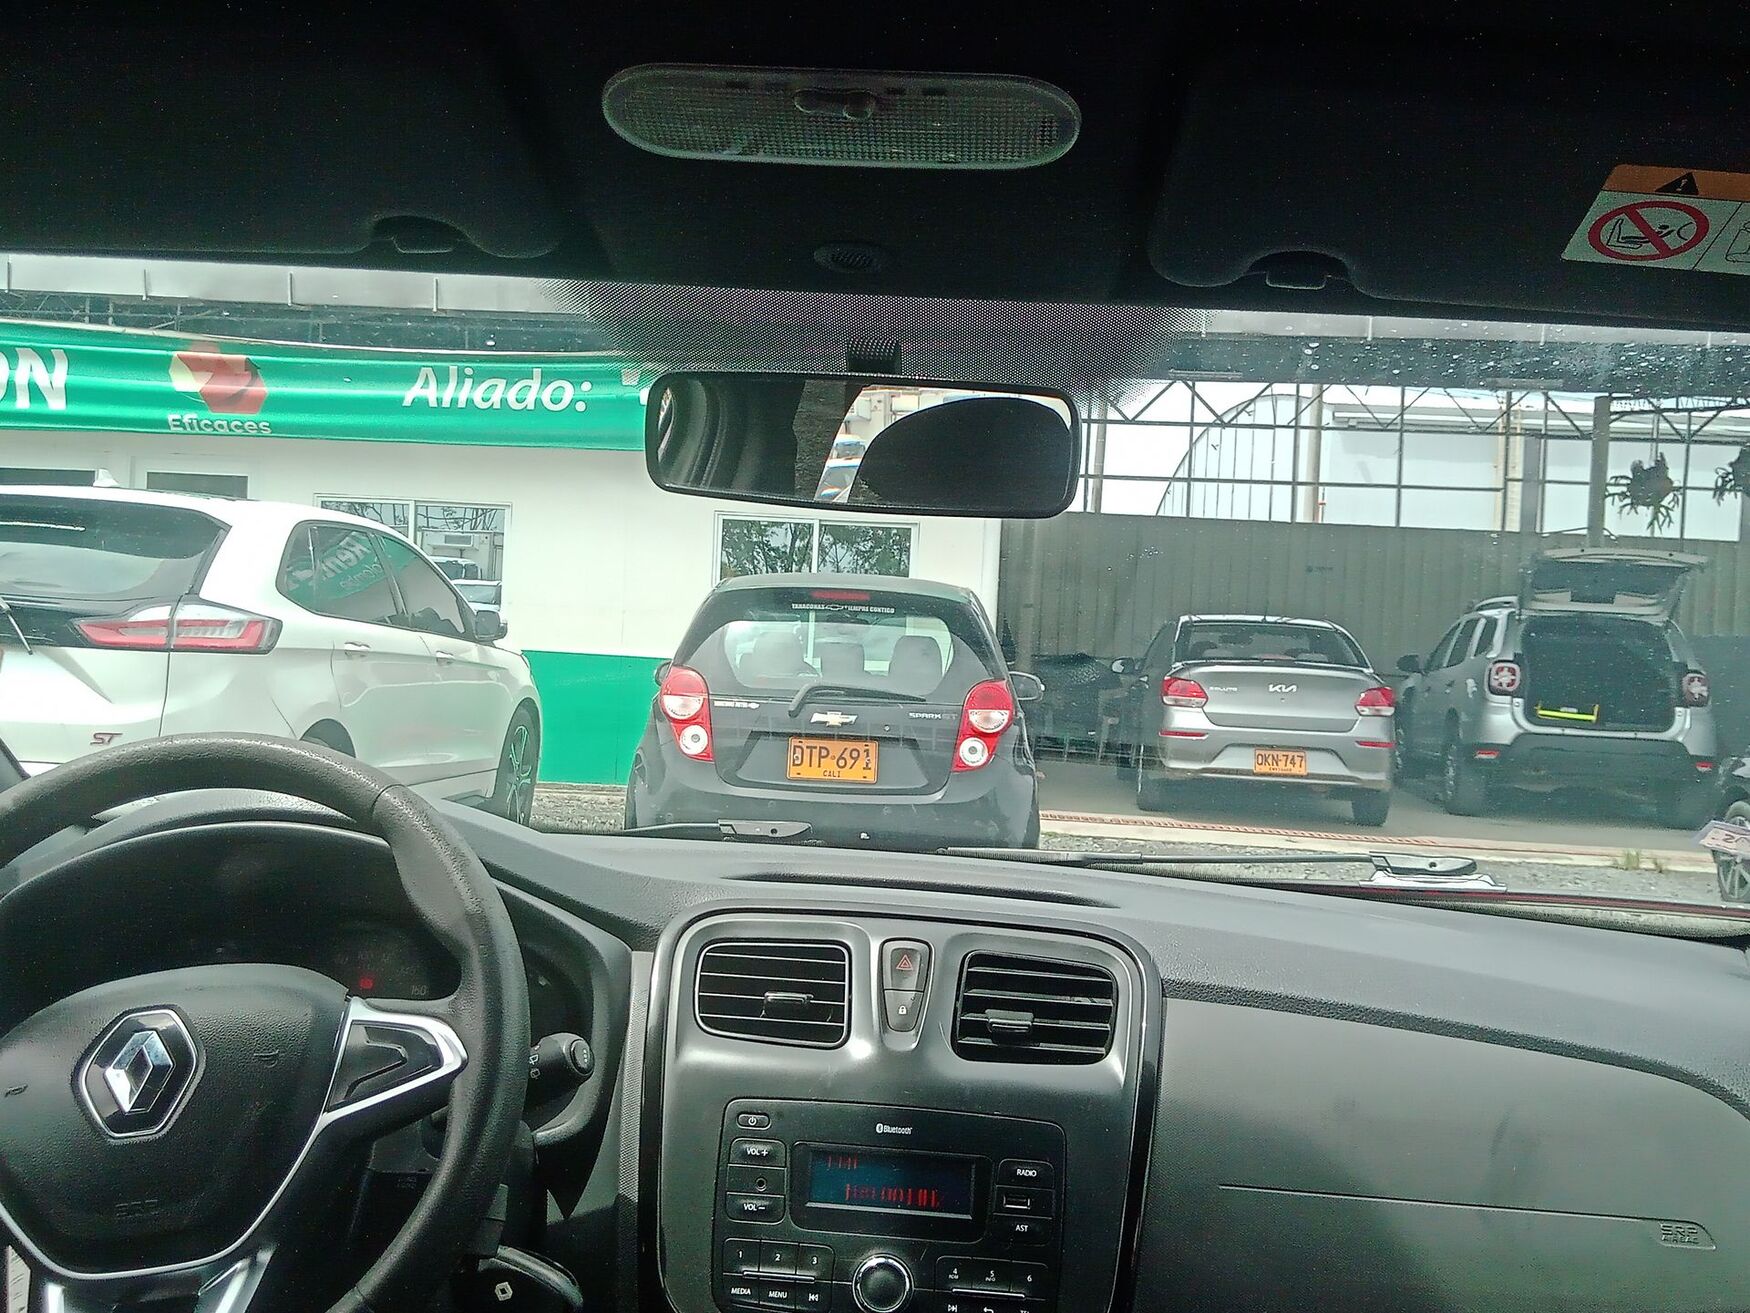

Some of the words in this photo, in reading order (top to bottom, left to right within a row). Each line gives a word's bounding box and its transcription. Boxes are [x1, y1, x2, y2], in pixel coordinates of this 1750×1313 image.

[0, 347, 68, 410] N
[402, 366, 592, 412] Aliado:
[167, 413, 272, 434] Eficaces
[90, 732, 123, 745] ST
[822, 769, 841, 778] CALI
[883, 1124, 912, 1135] Bluetooth
[1016, 1168, 1037, 1177] RADIO
[1015, 1224, 1029, 1232] AST
[738, 1250, 743, 1258] 1
[775, 1253, 781, 1261] 2
[812, 1256, 818, 1264] 3
[953, 1267, 958, 1275] 4
[1026, 1274, 1032, 1282] 6
[730, 1287, 751, 1296] MEDIA
[768, 1290, 788, 1299] MENU
